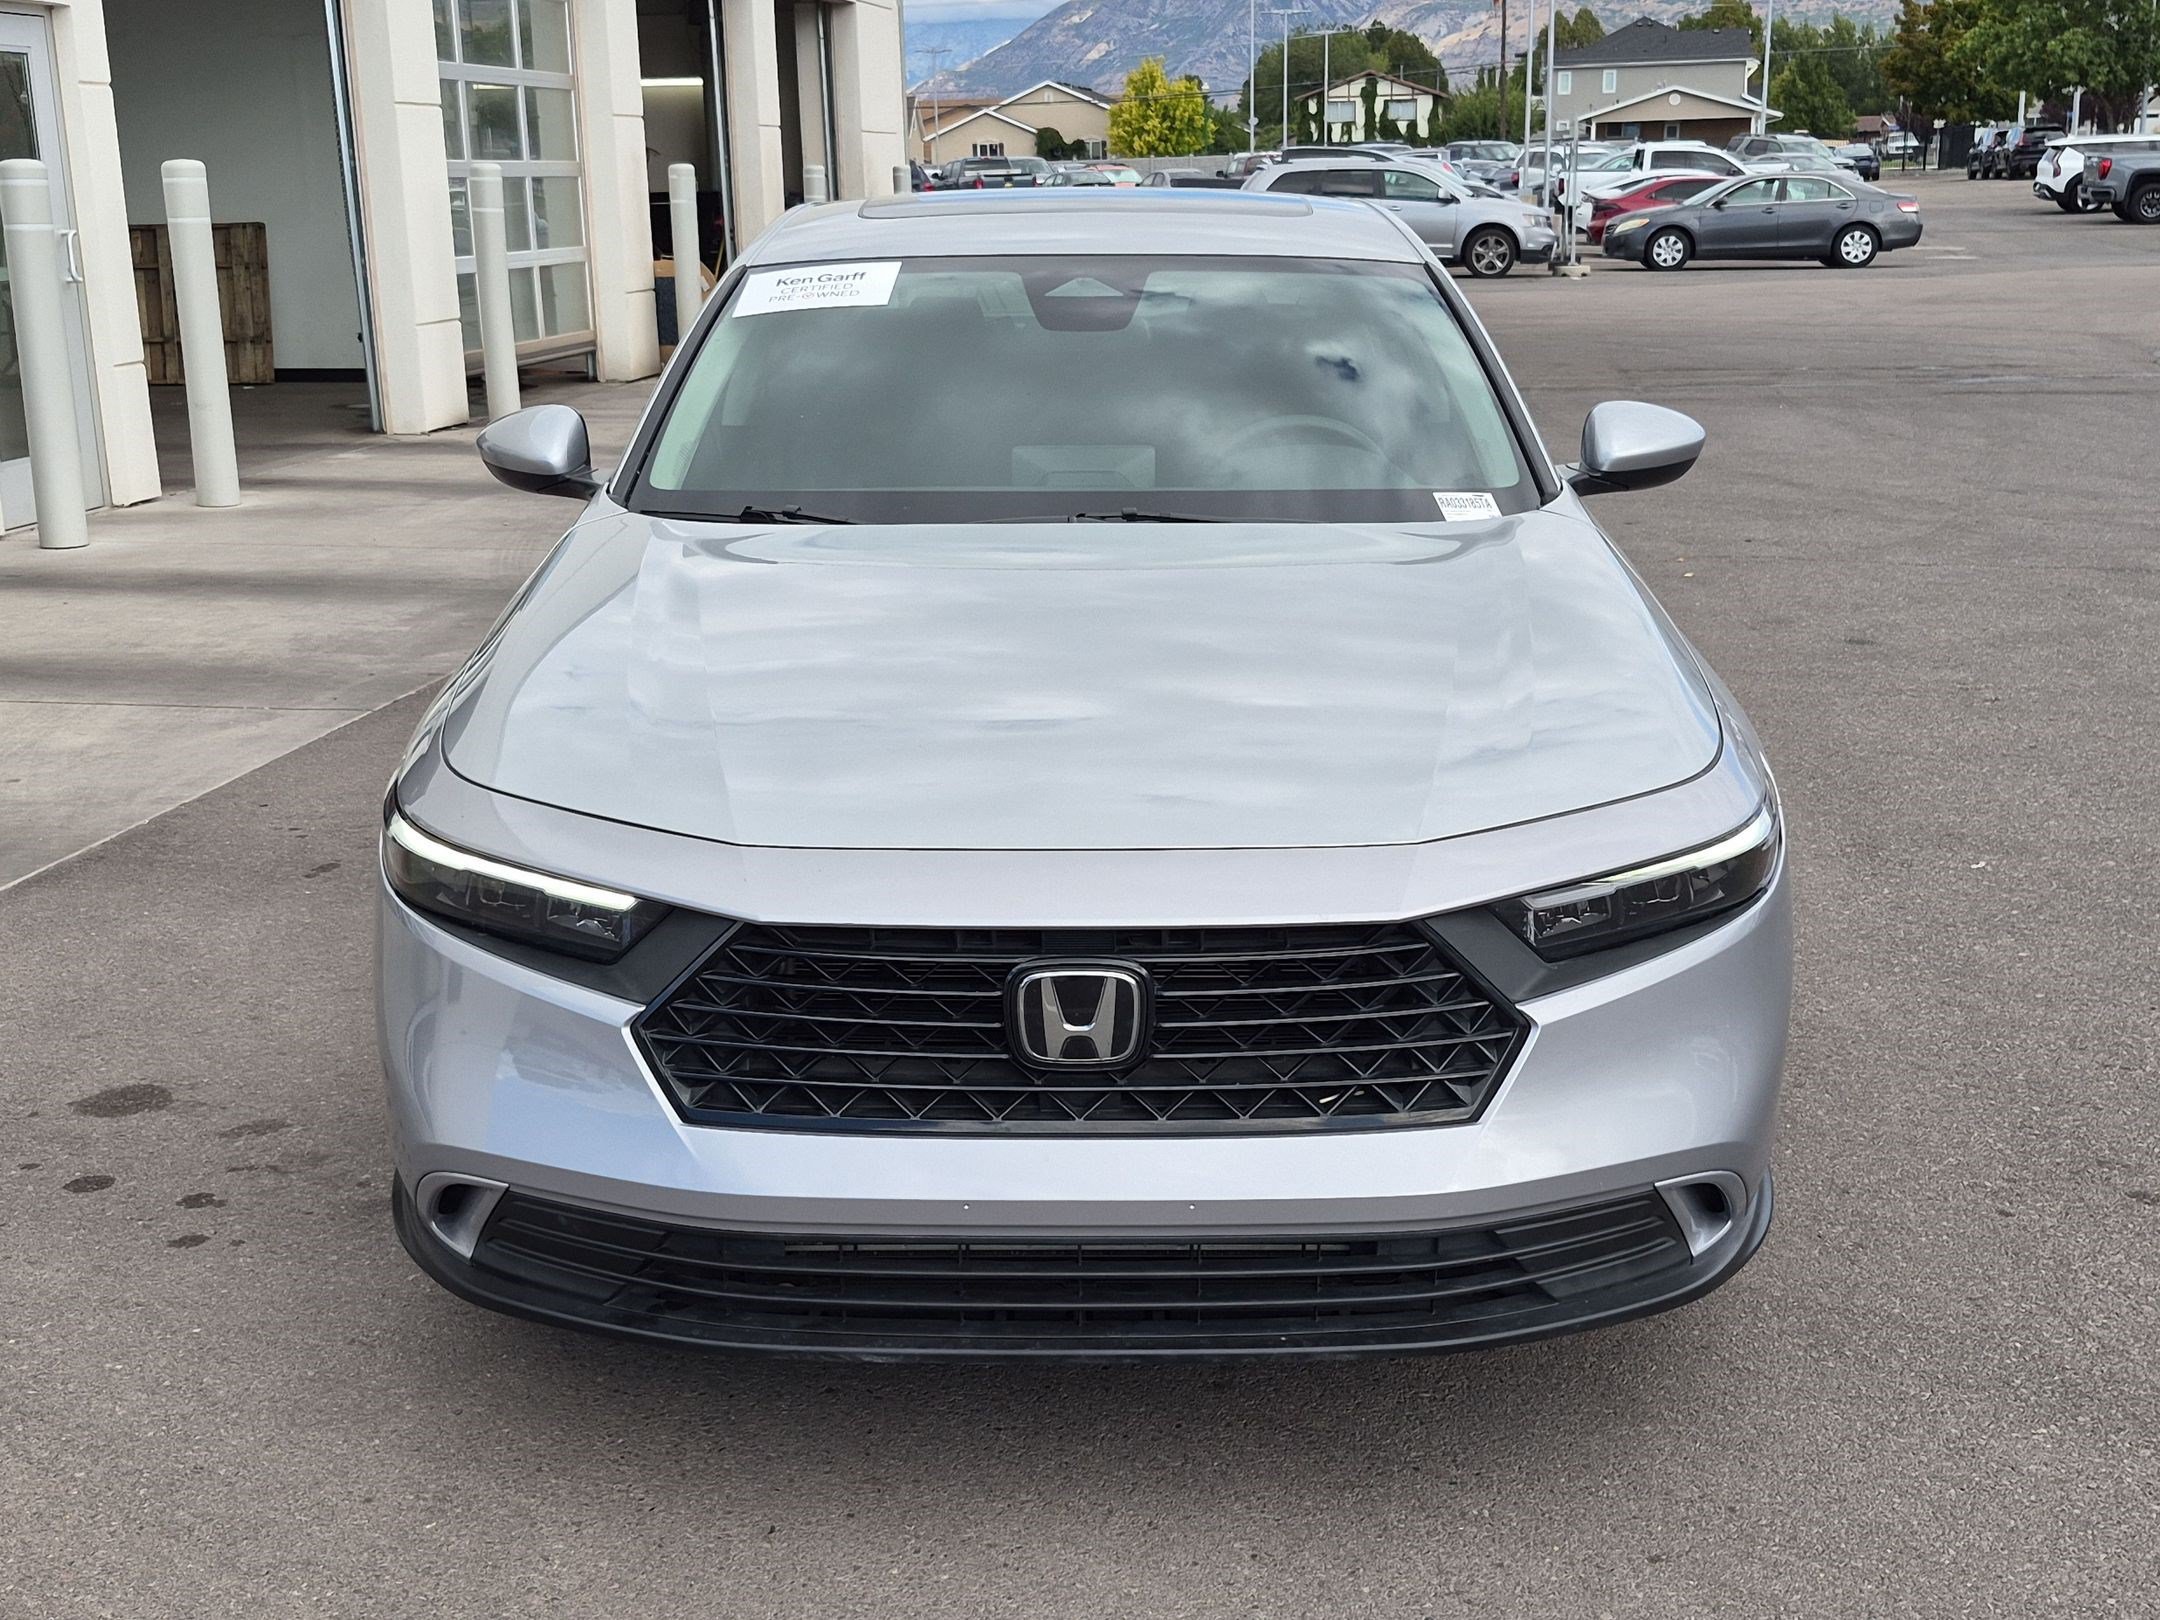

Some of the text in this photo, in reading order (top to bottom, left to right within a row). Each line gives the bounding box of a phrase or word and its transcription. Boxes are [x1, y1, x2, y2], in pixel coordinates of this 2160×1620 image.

[776, 272, 867, 287] Ken Garff
[780, 283, 853, 295] CERTIFIED
